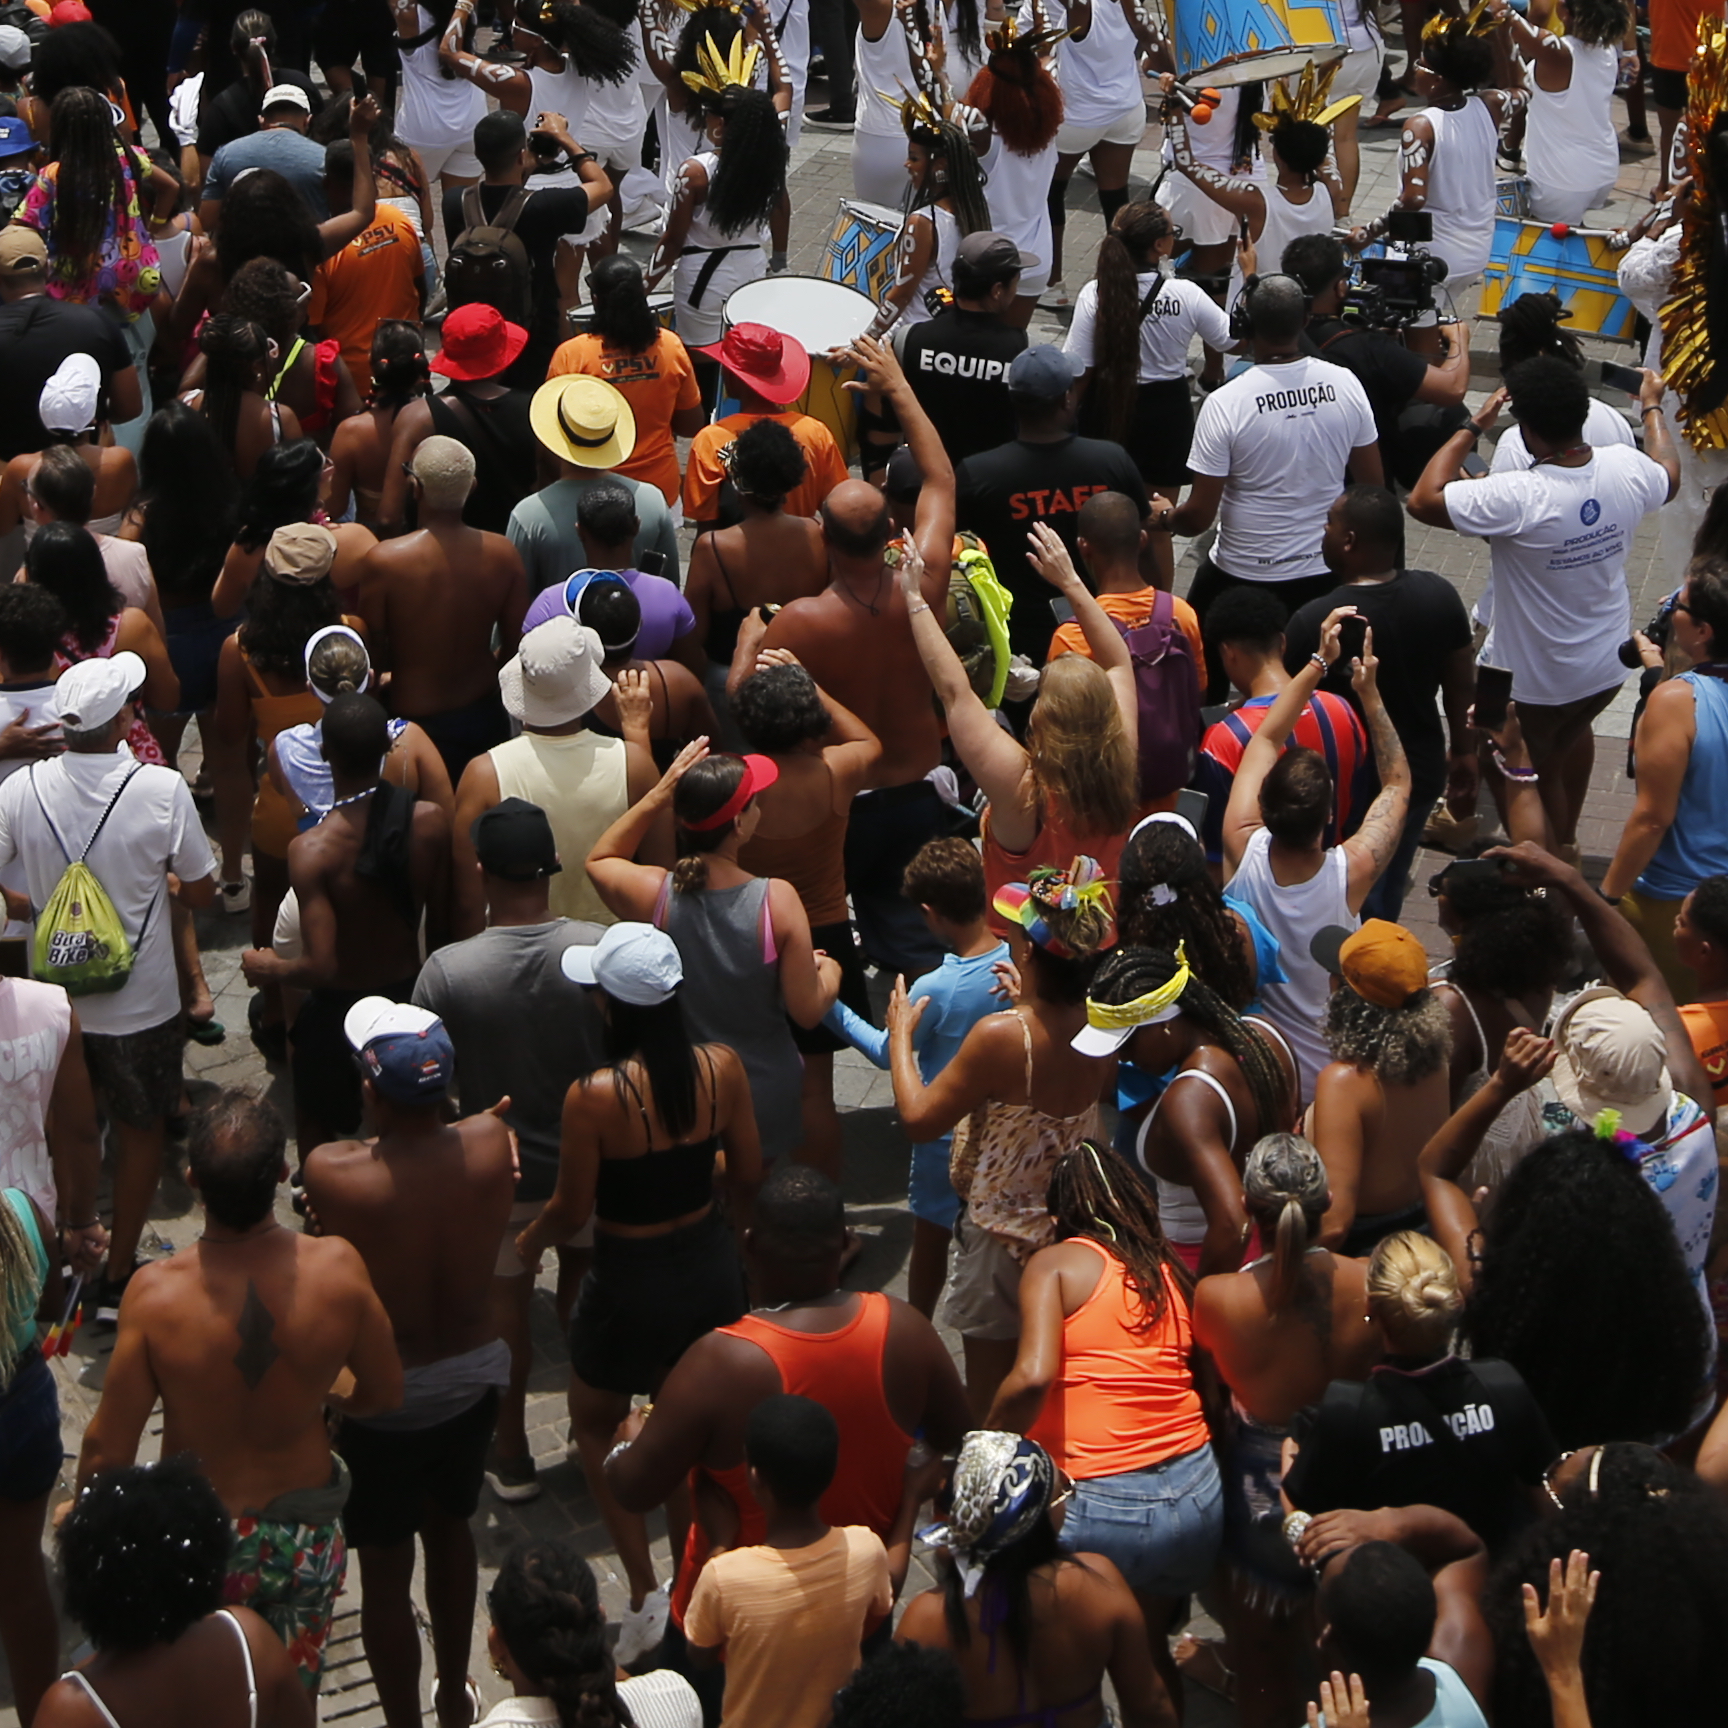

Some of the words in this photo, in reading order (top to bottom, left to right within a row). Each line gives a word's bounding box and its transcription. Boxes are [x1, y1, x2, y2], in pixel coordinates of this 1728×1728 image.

[361, 222, 395, 245] PSV
[615, 354, 658, 374] PSV
[1255, 381, 1337, 414] PRODUÇÃO
[47, 946, 89, 967] Bike
[1375, 1403, 1494, 1453] PROÇÃO
